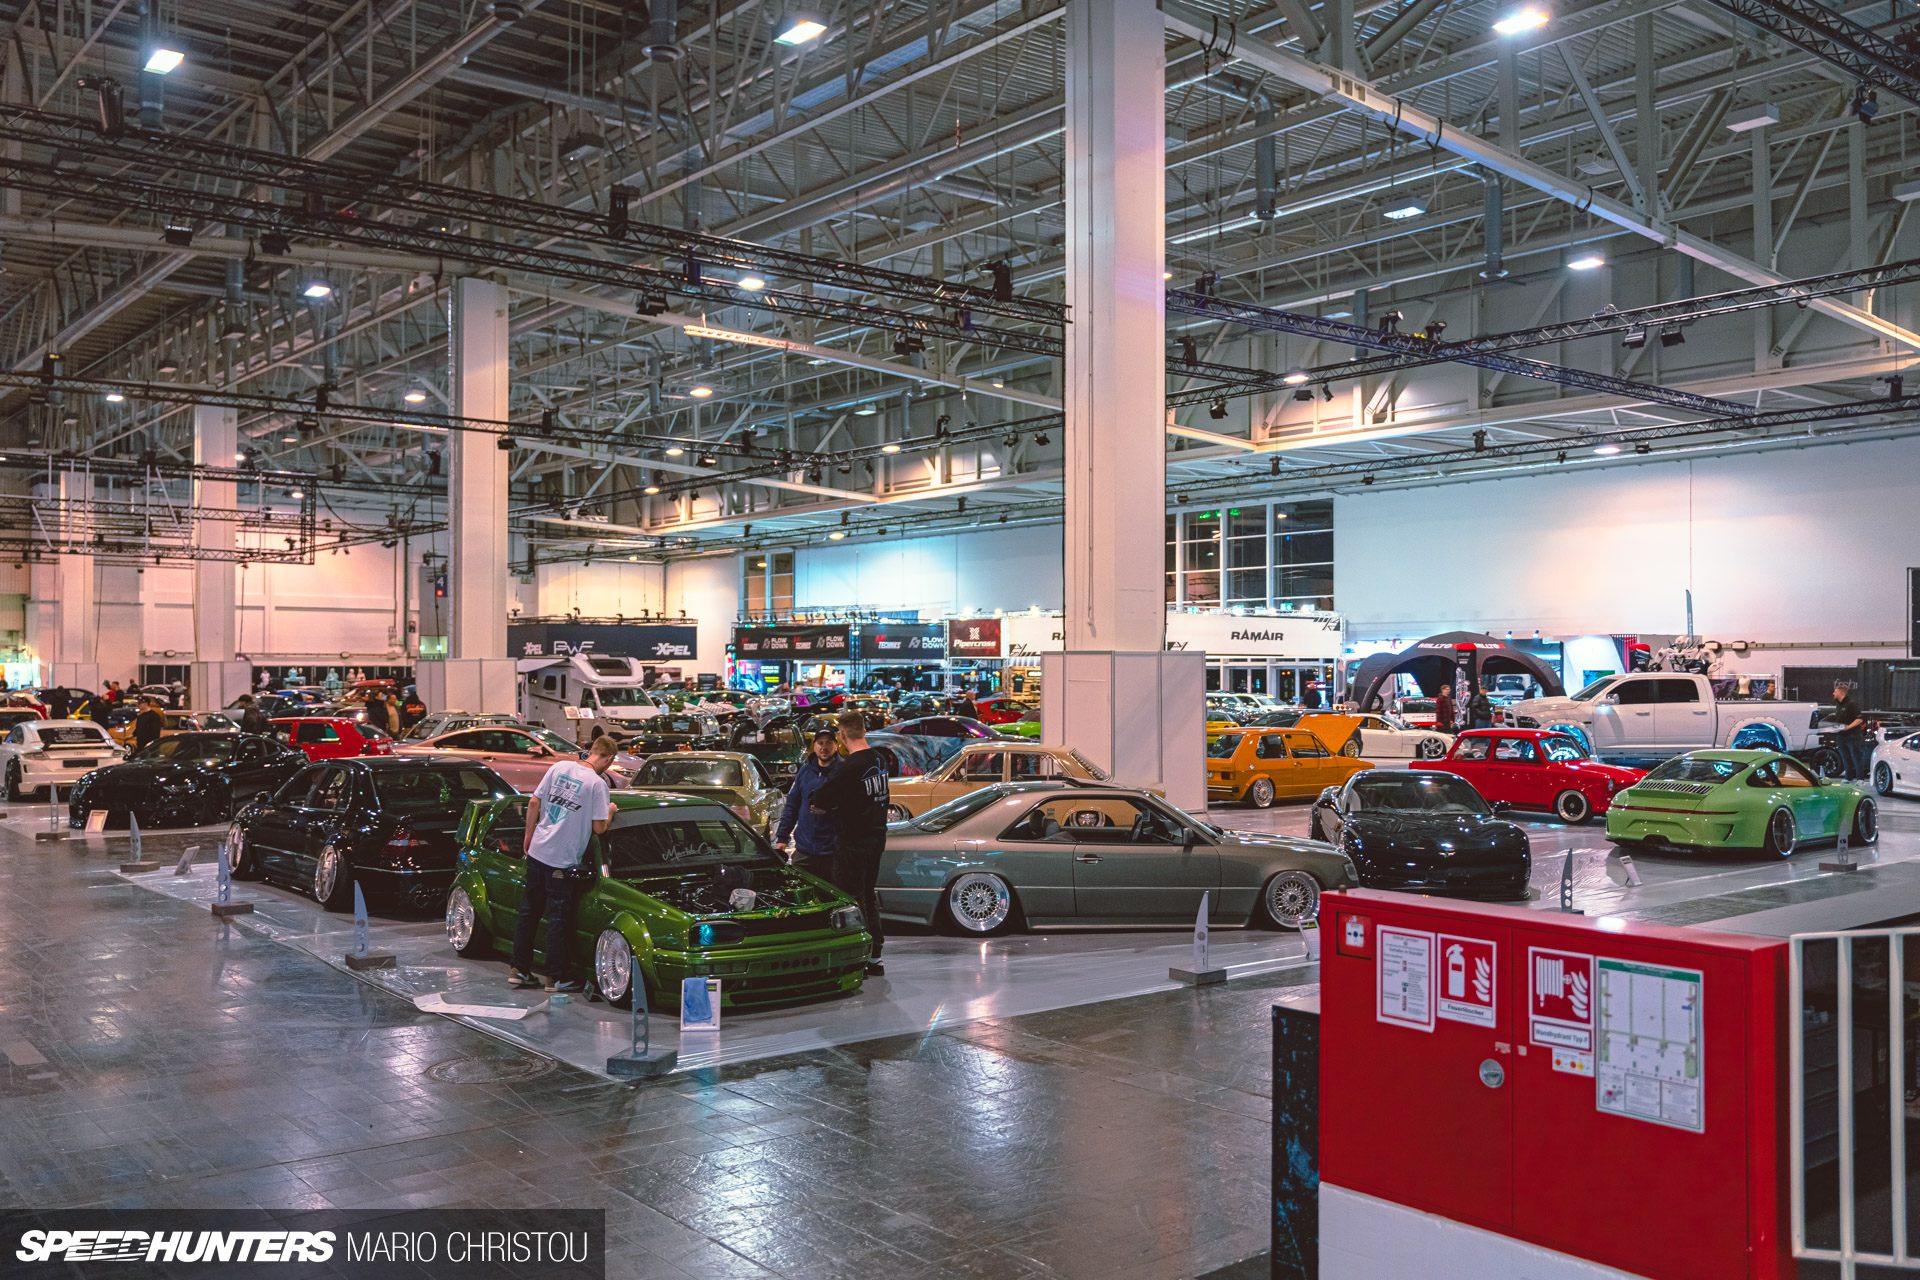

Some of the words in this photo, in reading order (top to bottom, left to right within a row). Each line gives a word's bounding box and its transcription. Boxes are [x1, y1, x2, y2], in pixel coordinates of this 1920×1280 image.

[436, 576, 444, 587] 4
[1230, 629, 1284, 642] RAMAIR
[524, 642, 543, 655] XPEL
[655, 642, 692, 656] XPEL
[953, 639, 997, 649] Pipercross
[1535, 1029, 1572, 1041] Wandhydrant
[1572, 1034, 1584, 1043] Typ
